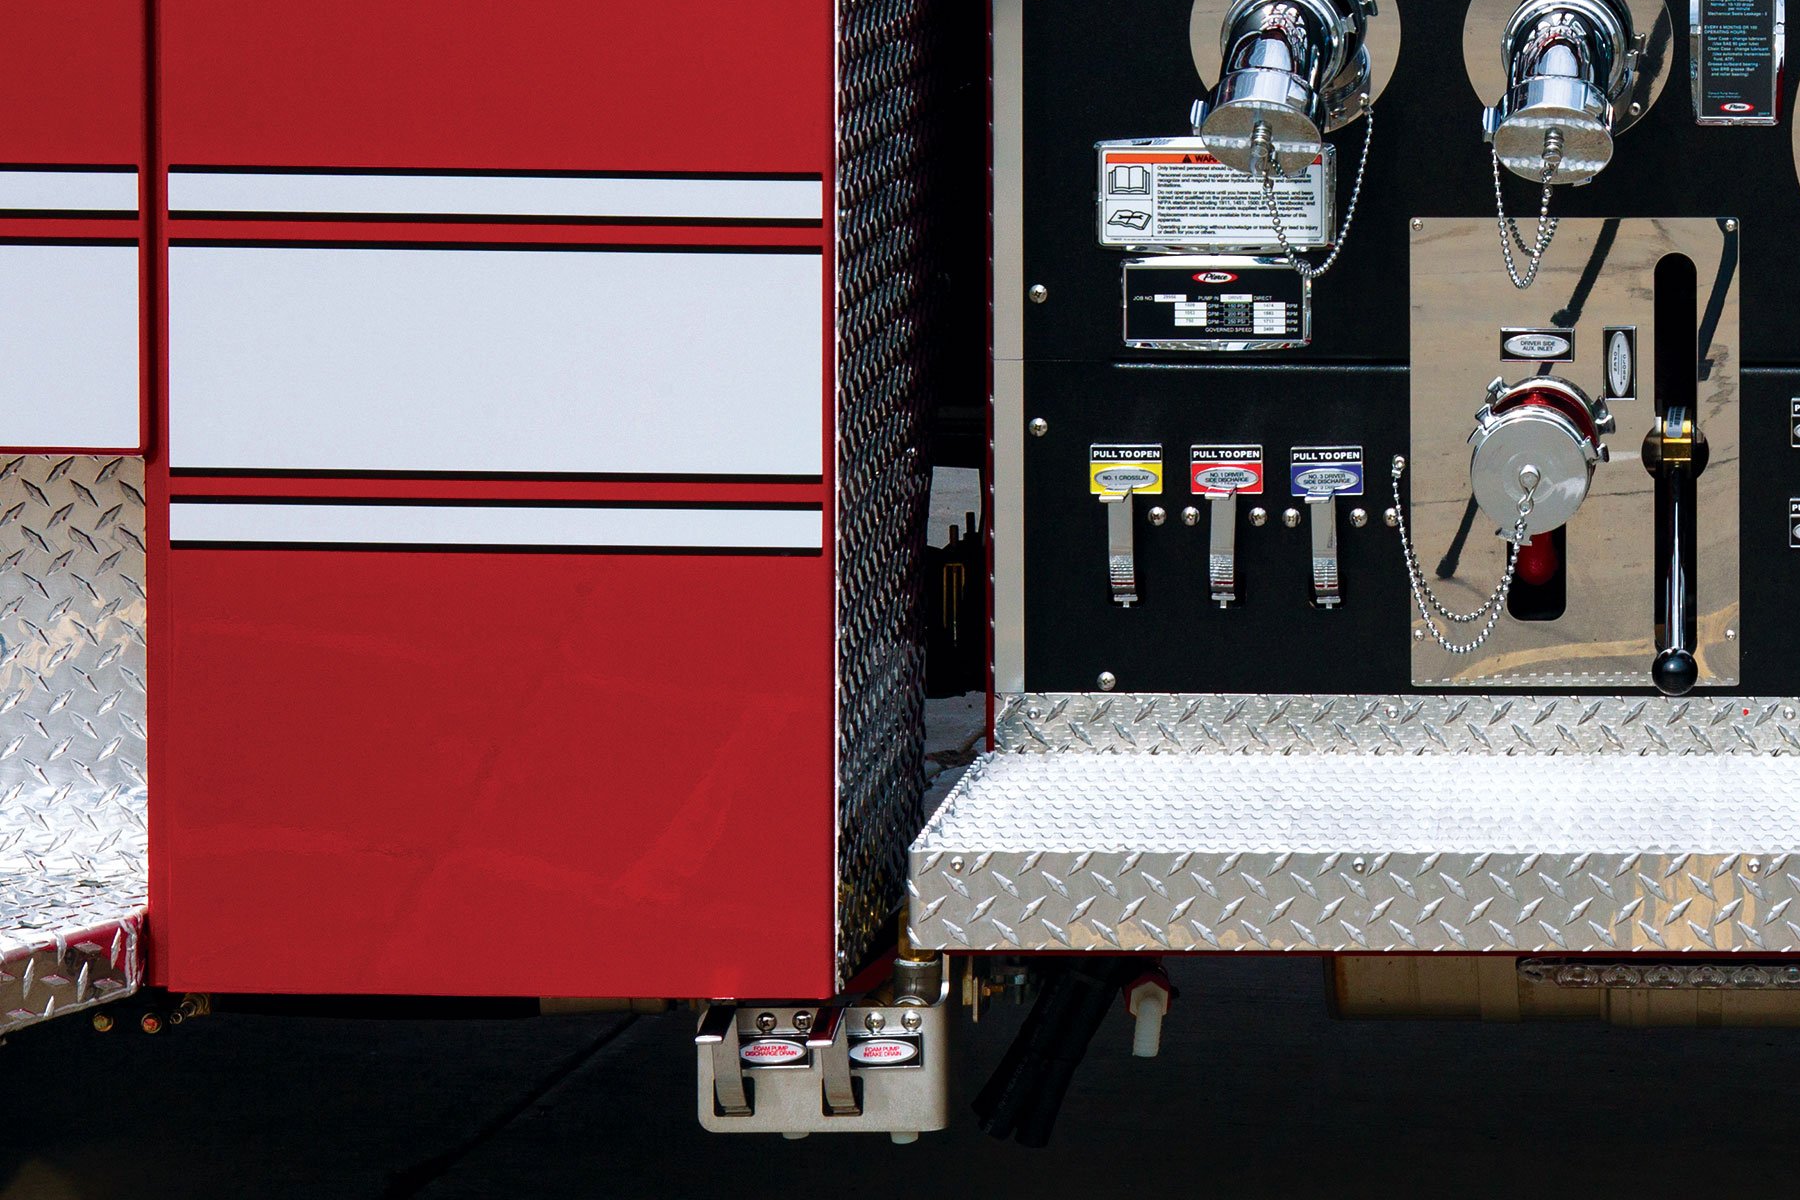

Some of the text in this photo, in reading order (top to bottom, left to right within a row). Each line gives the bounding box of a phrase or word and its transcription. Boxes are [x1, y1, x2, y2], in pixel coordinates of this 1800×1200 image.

[1093, 450, 1160, 458] PULL TO OPEN
[1193, 450, 1260, 458] PULL TO OPEN
[1293, 453, 1318, 461] PULL
[1319, 452, 1333, 460] TO
